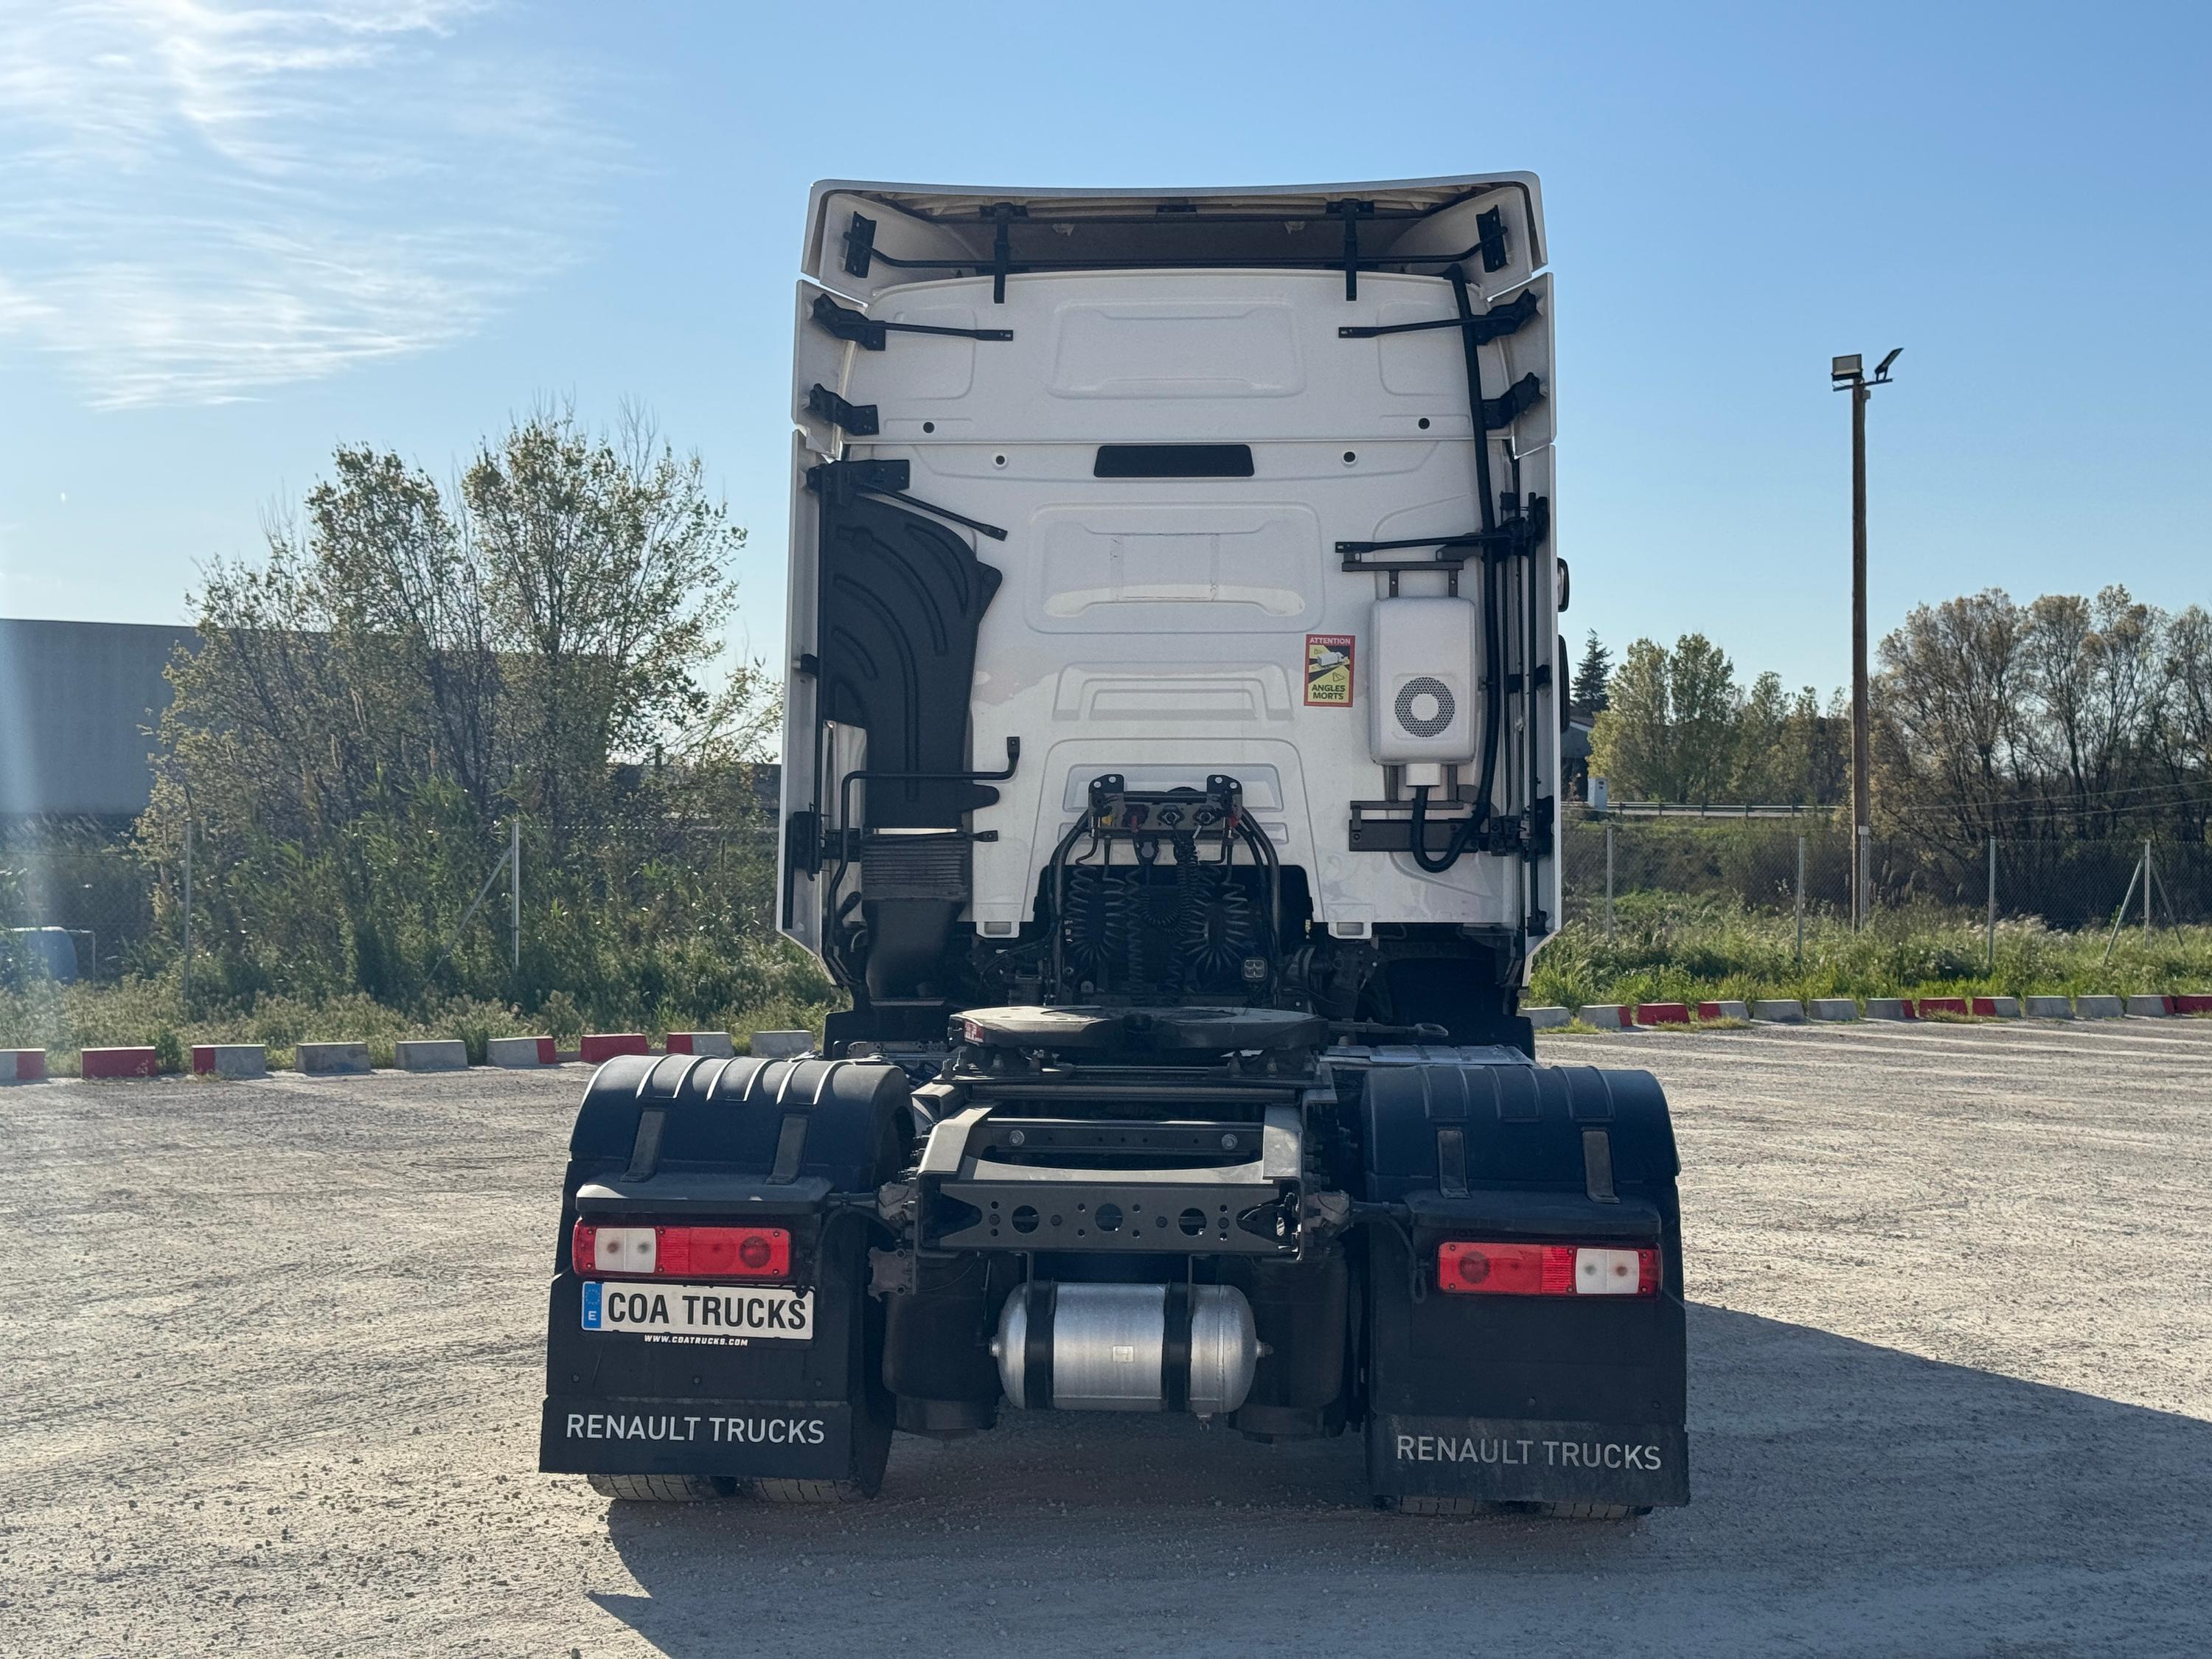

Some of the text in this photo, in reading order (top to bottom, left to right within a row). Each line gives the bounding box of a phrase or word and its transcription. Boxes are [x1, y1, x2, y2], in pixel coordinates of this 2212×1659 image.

[1312, 692, 1344, 700] MORTS
[588, 1310, 597, 1321] E
[608, 1293, 806, 1330] COA TRUCKS
[644, 1335, 748, 1346] WWW.COATRUCKS.COM
[566, 1413, 825, 1444] RENAULT TRUCKS
[1397, 1435, 1662, 1471] RENAULT TRUCKS
